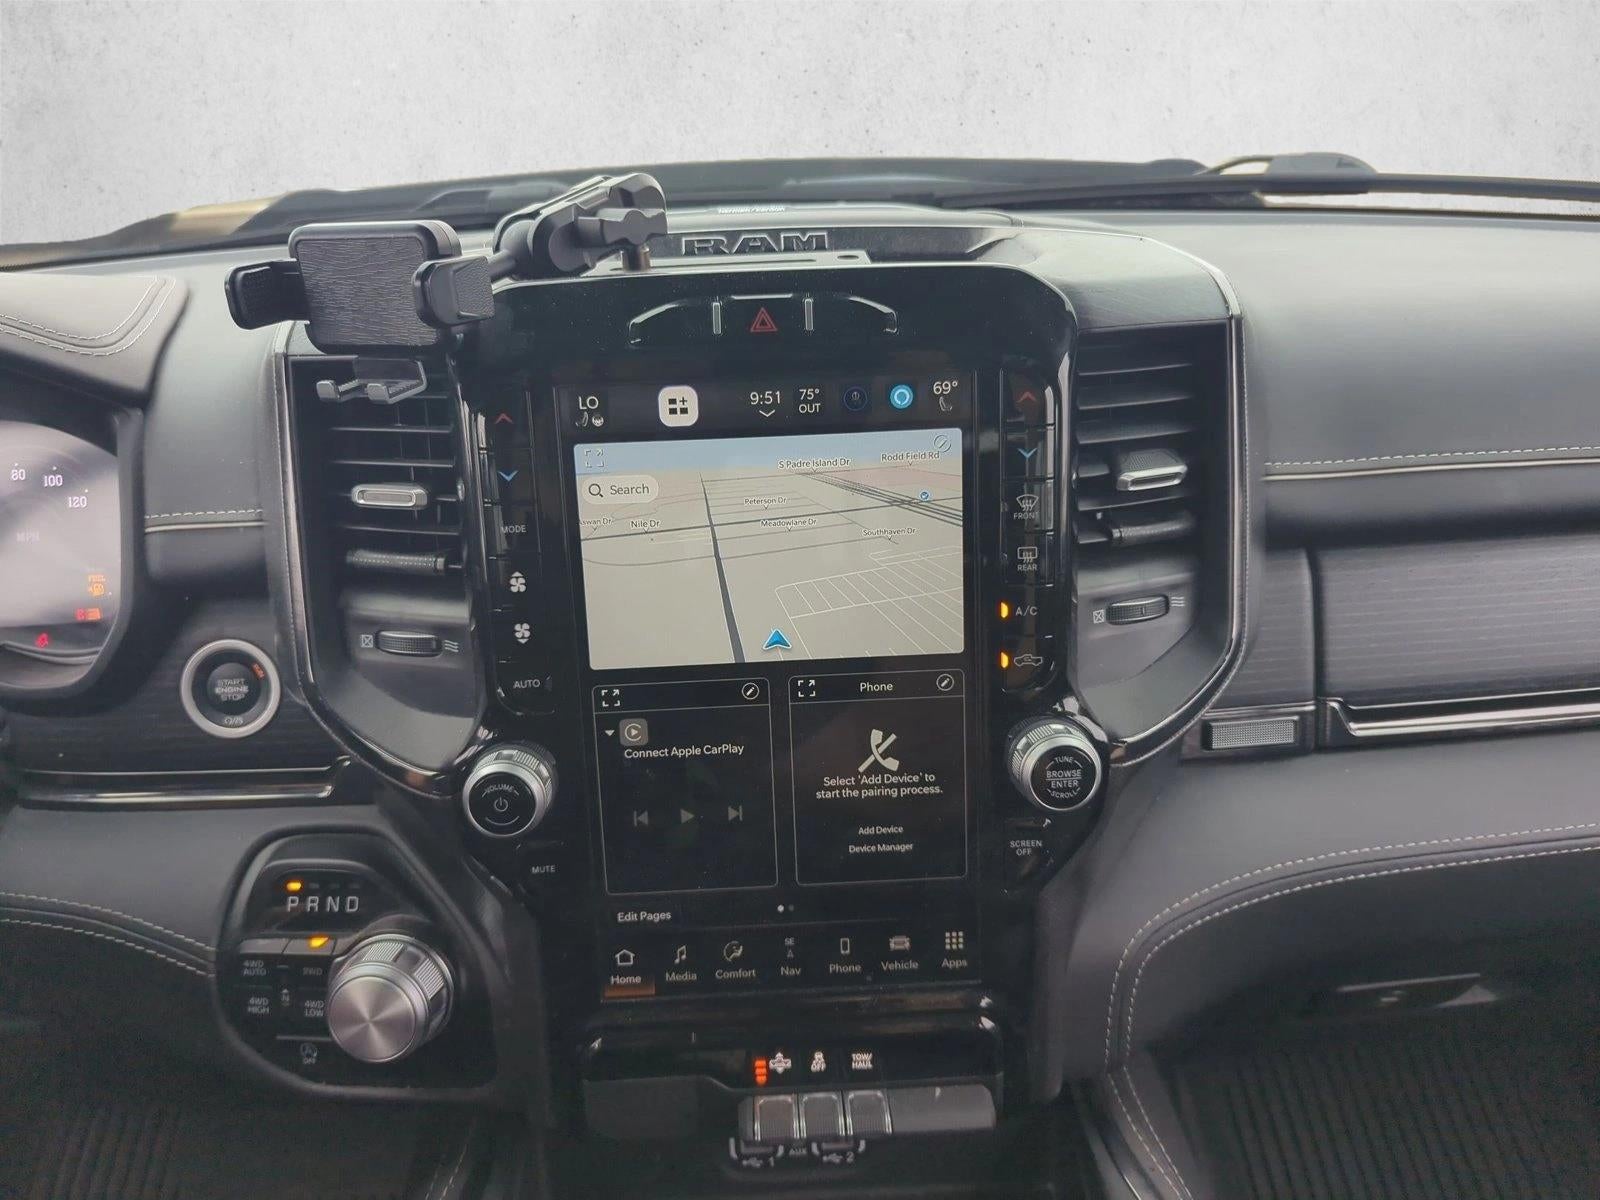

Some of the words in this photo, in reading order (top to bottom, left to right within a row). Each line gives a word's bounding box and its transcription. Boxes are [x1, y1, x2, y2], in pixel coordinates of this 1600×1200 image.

[680, 231, 829, 255] RAM
[578, 396, 599, 410] LO
[750, 391, 781, 405] 9:51
[798, 403, 820, 414] OUT
[881, 453, 902, 462] Rodd
[904, 451, 925, 461] Field
[927, 450, 940, 460] Rd
[778, 460, 785, 469] S
[786, 459, 811, 469] Padre
[812, 458, 835, 468] Island
[837, 457, 852, 467] Dr
[43, 475, 63, 487] 100
[609, 483, 650, 496] Search
[68, 496, 87, 508] 120
[744, 497, 775, 506] Peterson
[777, 496, 787, 505] Dr
[1013, 512, 1039, 520] FRONT
[631, 520, 648, 528] Nile
[649, 519, 660, 528] Dr
[760, 519, 807, 528] Meadowlane
[808, 517, 817, 526] Dr
[501, 525, 527, 534] MODE
[862, 528, 905, 538] Southhaven
[907, 527, 916, 536] Dr
[1017, 564, 1038, 572] REAR
[1015, 605, 1038, 616] A/C
[215, 685, 249, 694] ENGINE
[513, 679, 541, 689] AUTO
[859, 682, 894, 692] Phone
[624, 748, 669, 759] Connect
[671, 746, 702, 758] Apple
[703, 743, 745, 758] CarPlay
[1054, 756, 1074, 764] TUNE
[823, 775, 855, 786] Select
[924, 773, 936, 783] to
[1046, 769, 1082, 779] BROWSE
[486, 783, 515, 794] VOLUME
[1051, 780, 1079, 789] ENTER
[816, 788, 840, 799] start
[841, 787, 860, 798] the
[861, 786, 898, 800] pairing
[900, 784, 943, 798] process.
[1050, 790, 1078, 799] SCROLL
[857, 825, 875, 835] Add
[876, 824, 904, 835] Device
[848, 843, 875, 854] Device
[876, 842, 914, 855] Manager
[1009, 839, 1043, 848] SCREEN
[1015, 848, 1032, 857] OFF
[531, 865, 556, 874] MUTE
[617, 911, 638, 922] Edit
[640, 910, 672, 924] Pages
[829, 962, 862, 974] Phone
[881, 959, 919, 971] Vehicle
[941, 958, 968, 970] Apps
[665, 971, 698, 982] Media
[715, 969, 757, 980] Comfort
[780, 966, 801, 976] Nav
[610, 974, 642, 985] Home
